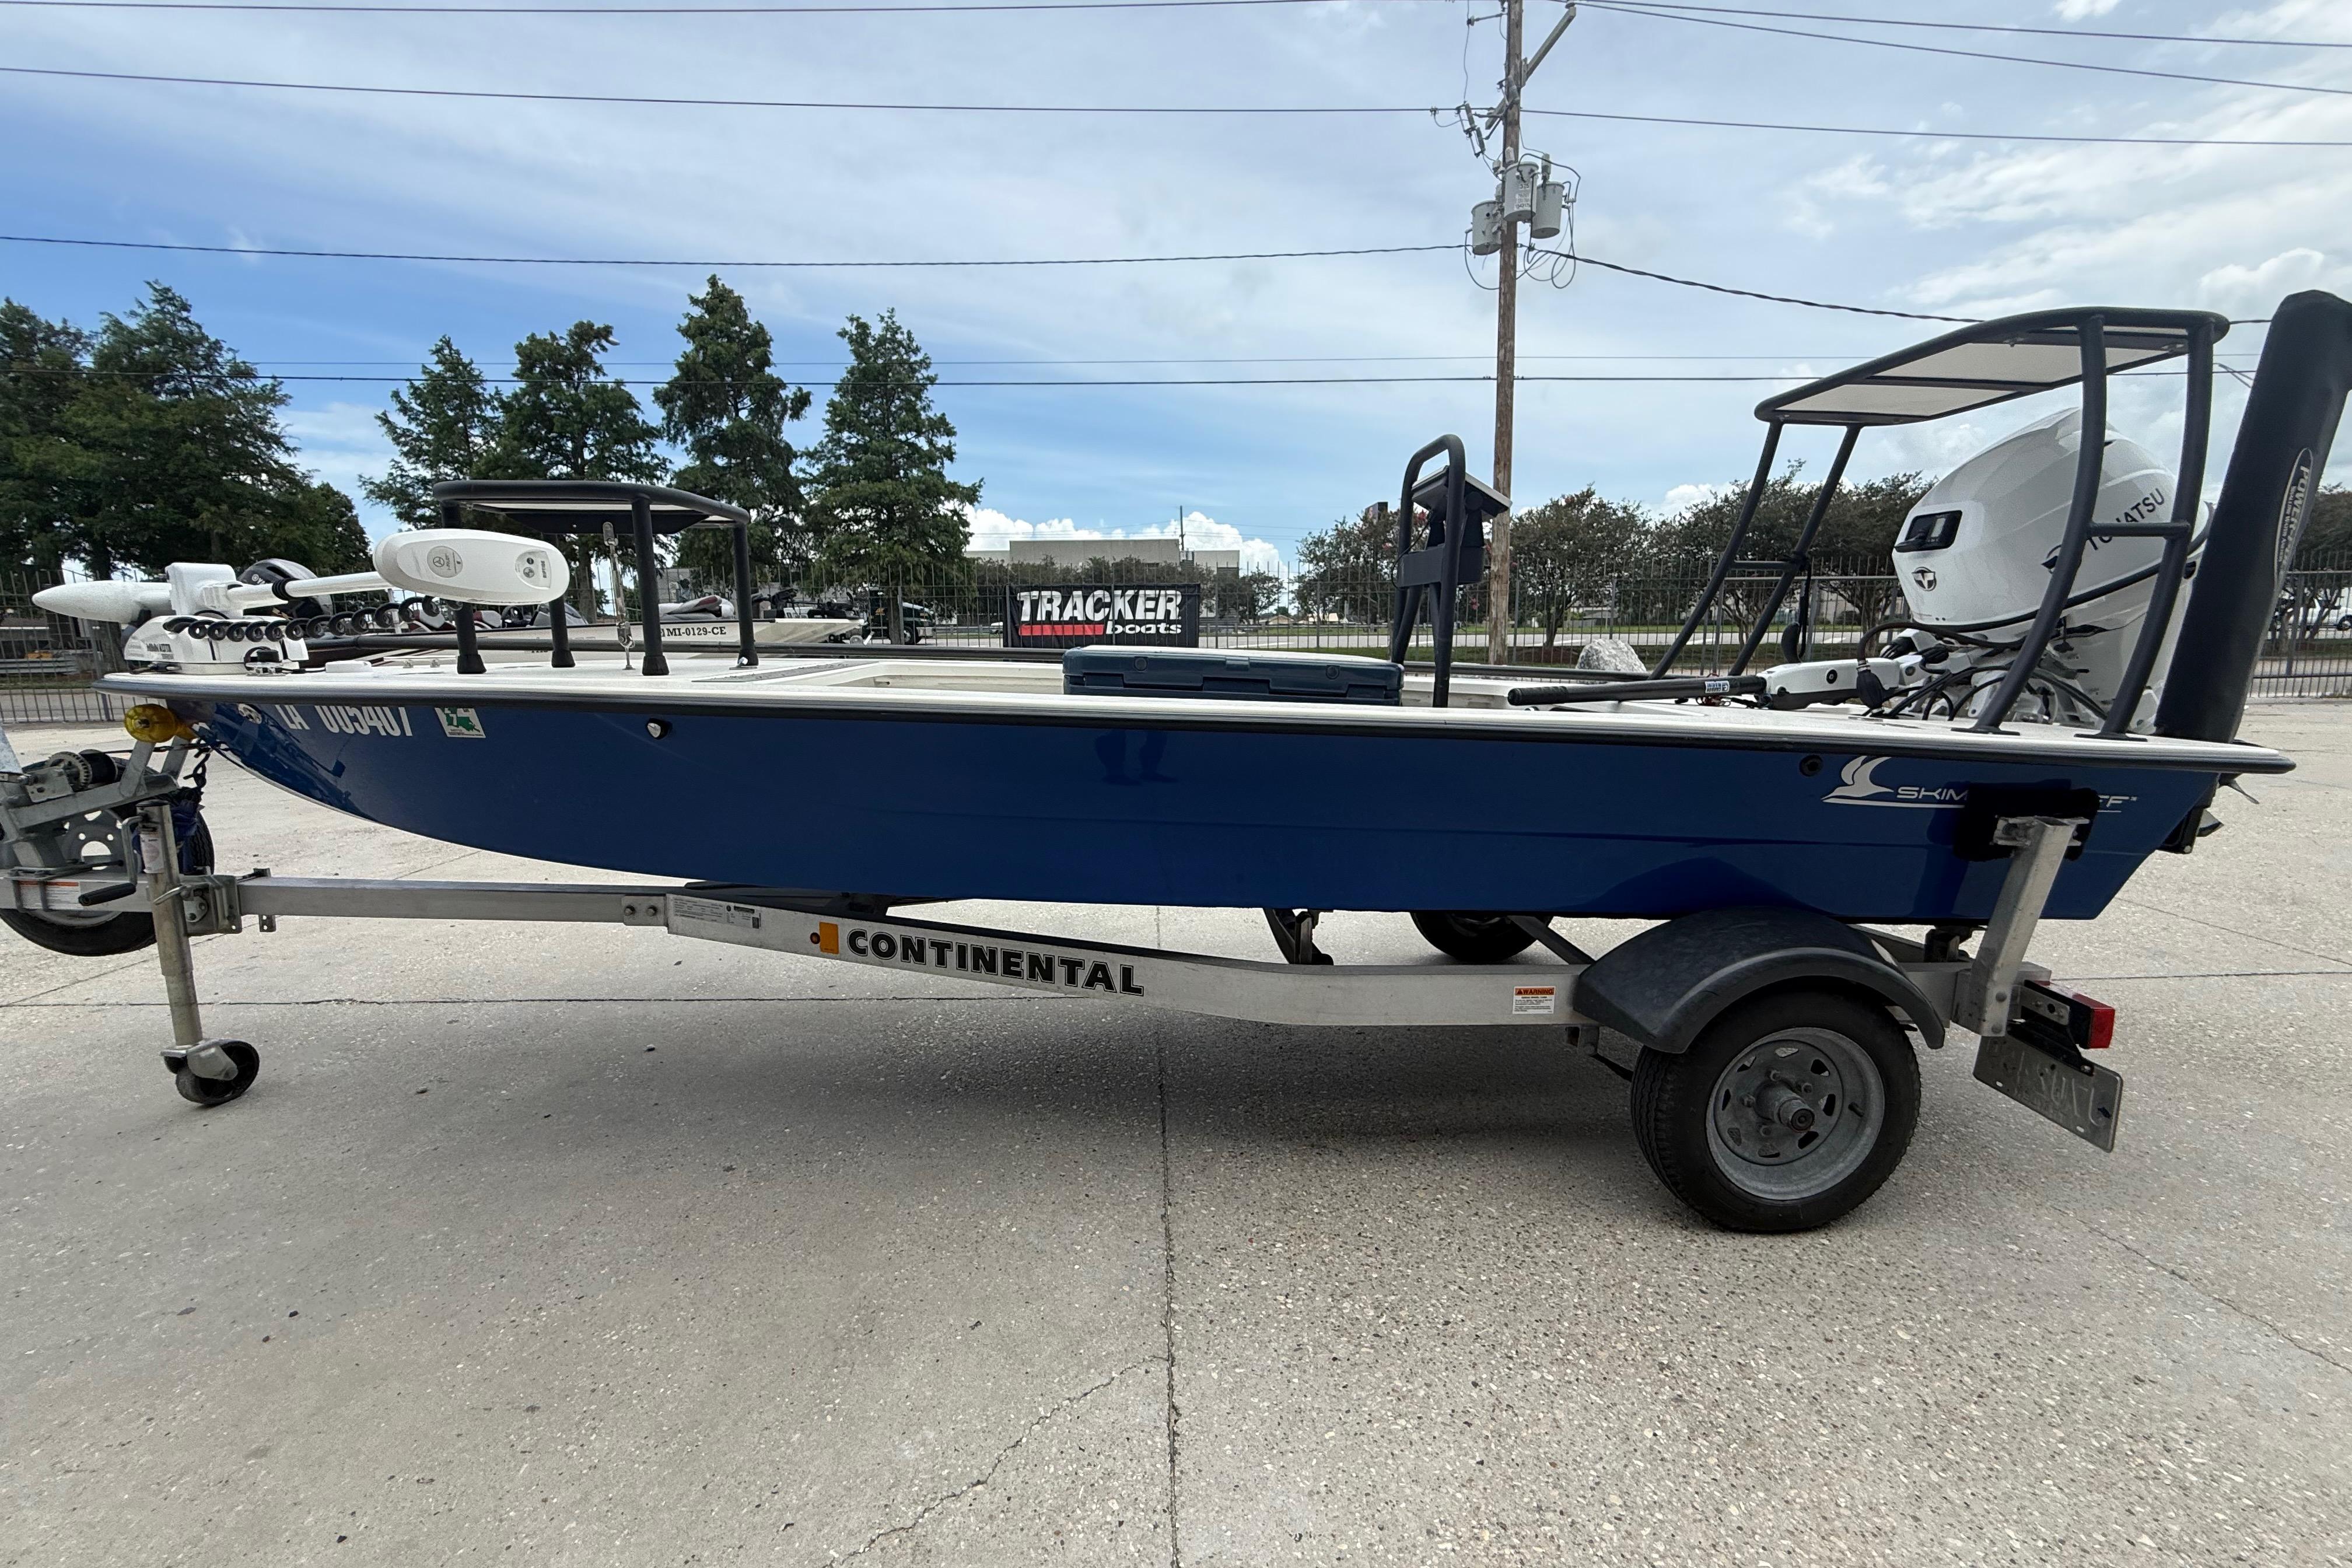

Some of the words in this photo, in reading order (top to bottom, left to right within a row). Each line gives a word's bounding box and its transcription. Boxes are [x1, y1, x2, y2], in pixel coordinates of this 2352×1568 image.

[1017, 590, 1182, 621] TRACKER
[666, 626, 726, 637] MI-0129-CE
[1105, 621, 1182, 635] boats
[275, 705, 310, 730] LA
[847, 929, 1144, 997] CONTINENTAL
